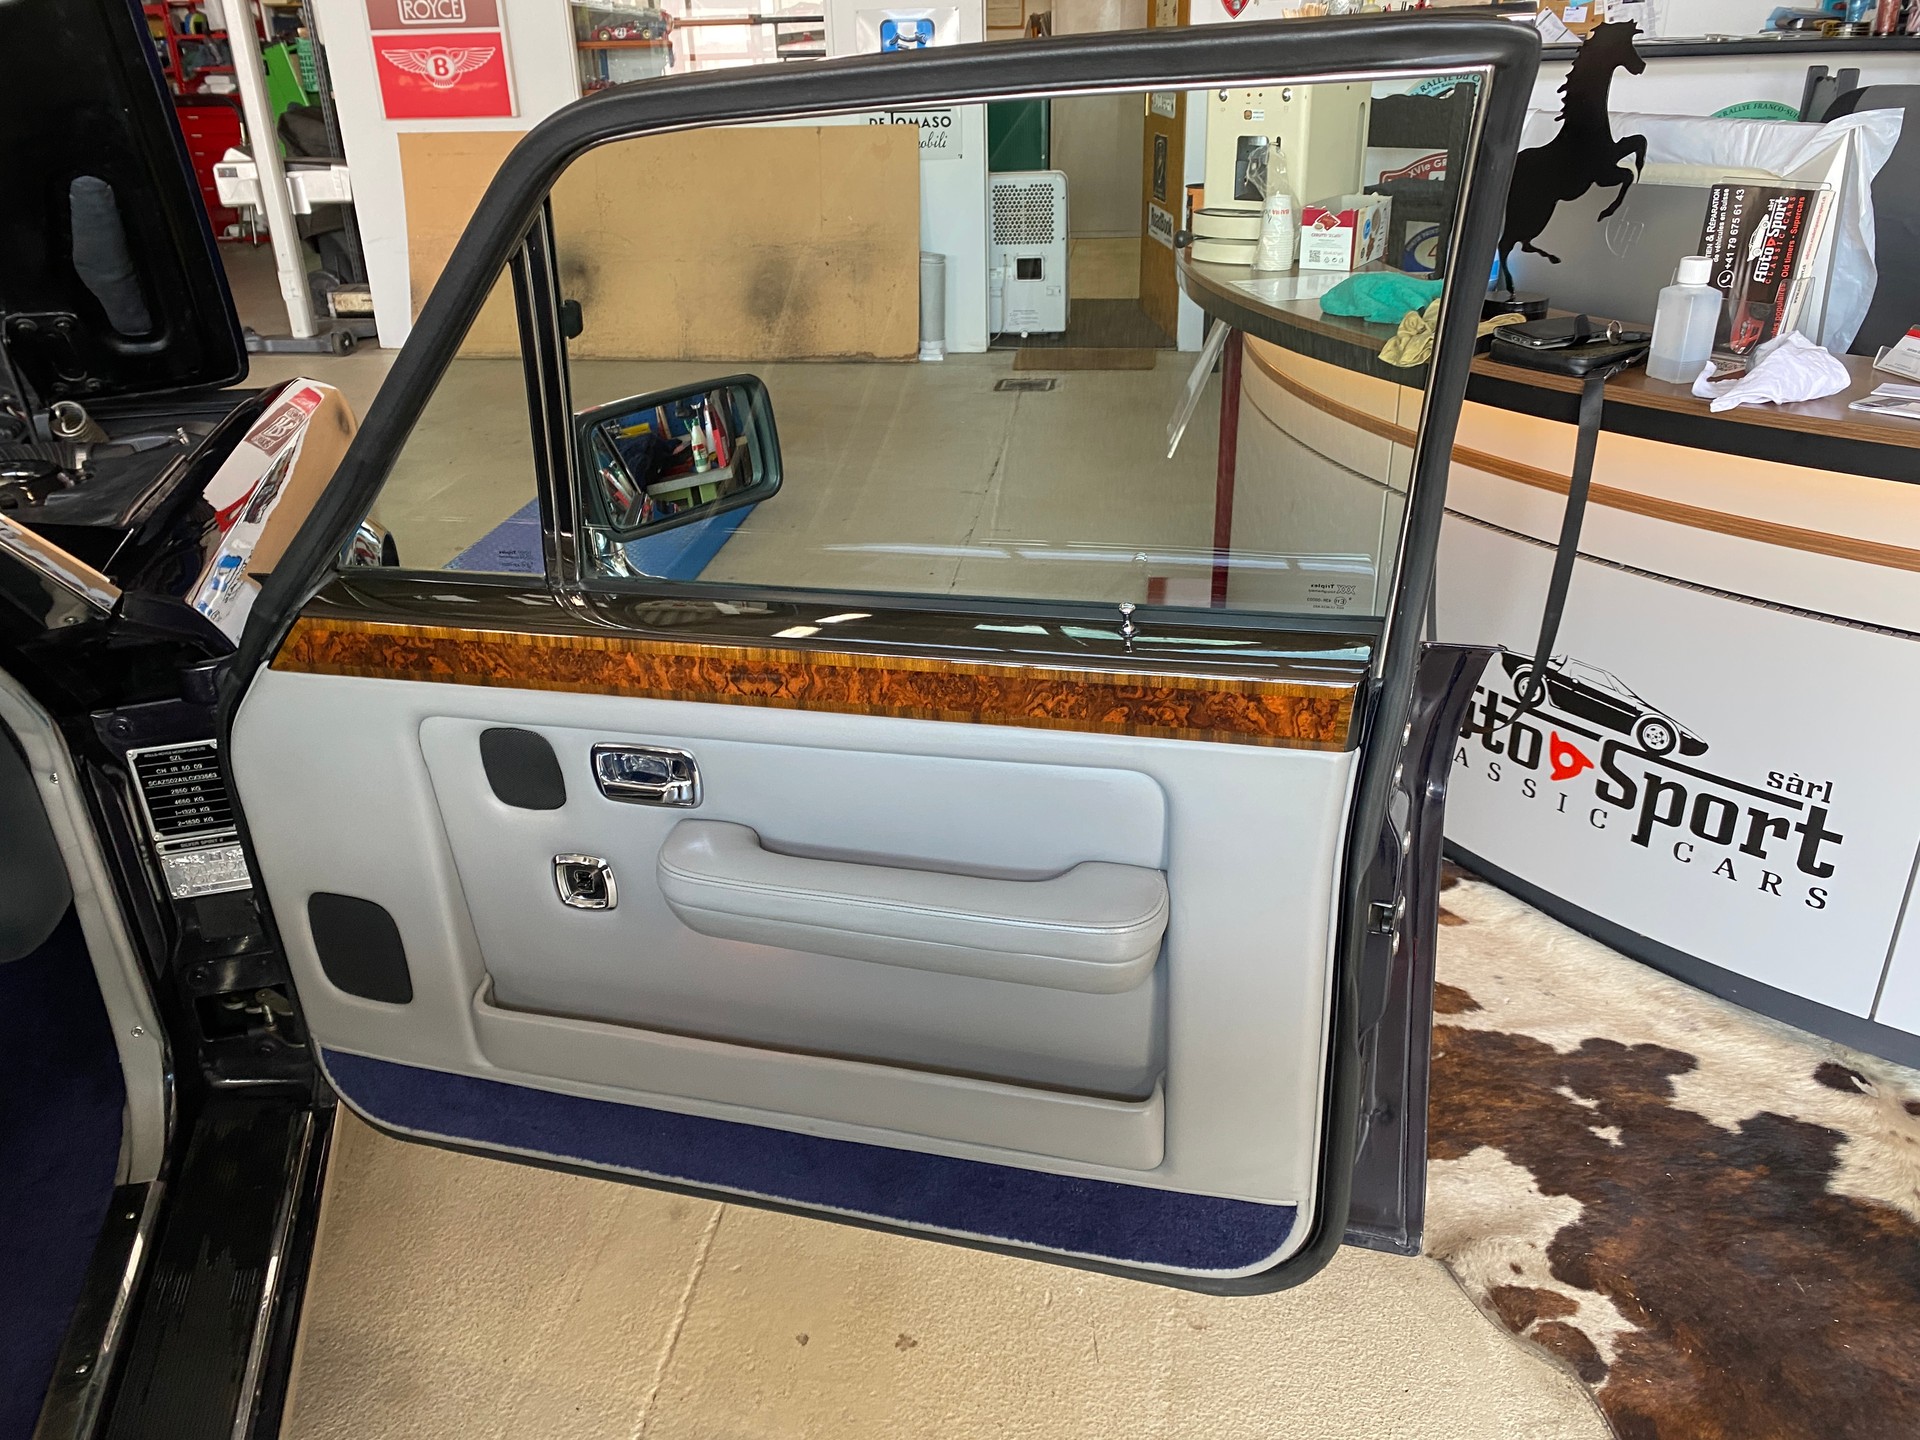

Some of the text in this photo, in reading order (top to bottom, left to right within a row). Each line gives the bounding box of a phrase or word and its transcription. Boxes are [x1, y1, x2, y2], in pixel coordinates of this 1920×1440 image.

[402, 0, 462, 19] ROYCE
[432, 57, 450, 76] B
[884, 108, 952, 128] TOMASO
[1723, 103, 1751, 117] RALLYE
[919, 131, 948, 149] obili
[1721, 188, 1730, 212] Suisse
[1790, 196, 1806, 235] Supercars
[1725, 188, 1745, 270] +41 79 675 61 43
[1753, 196, 1790, 284] Auto Sport
[1764, 196, 1797, 285] CLASSIC CARS
[1784, 239, 1796, 263] timers
[1780, 262, 1789, 278] Old
[191, 785, 202, 793] KG
[1766, 770, 1834, 804] sàrl
[193, 796, 205, 804] KG
[199, 805, 210, 813] KG
[1595, 738, 1843, 880] Sport
[1453, 745, 1830, 911] ASSIC CARS
